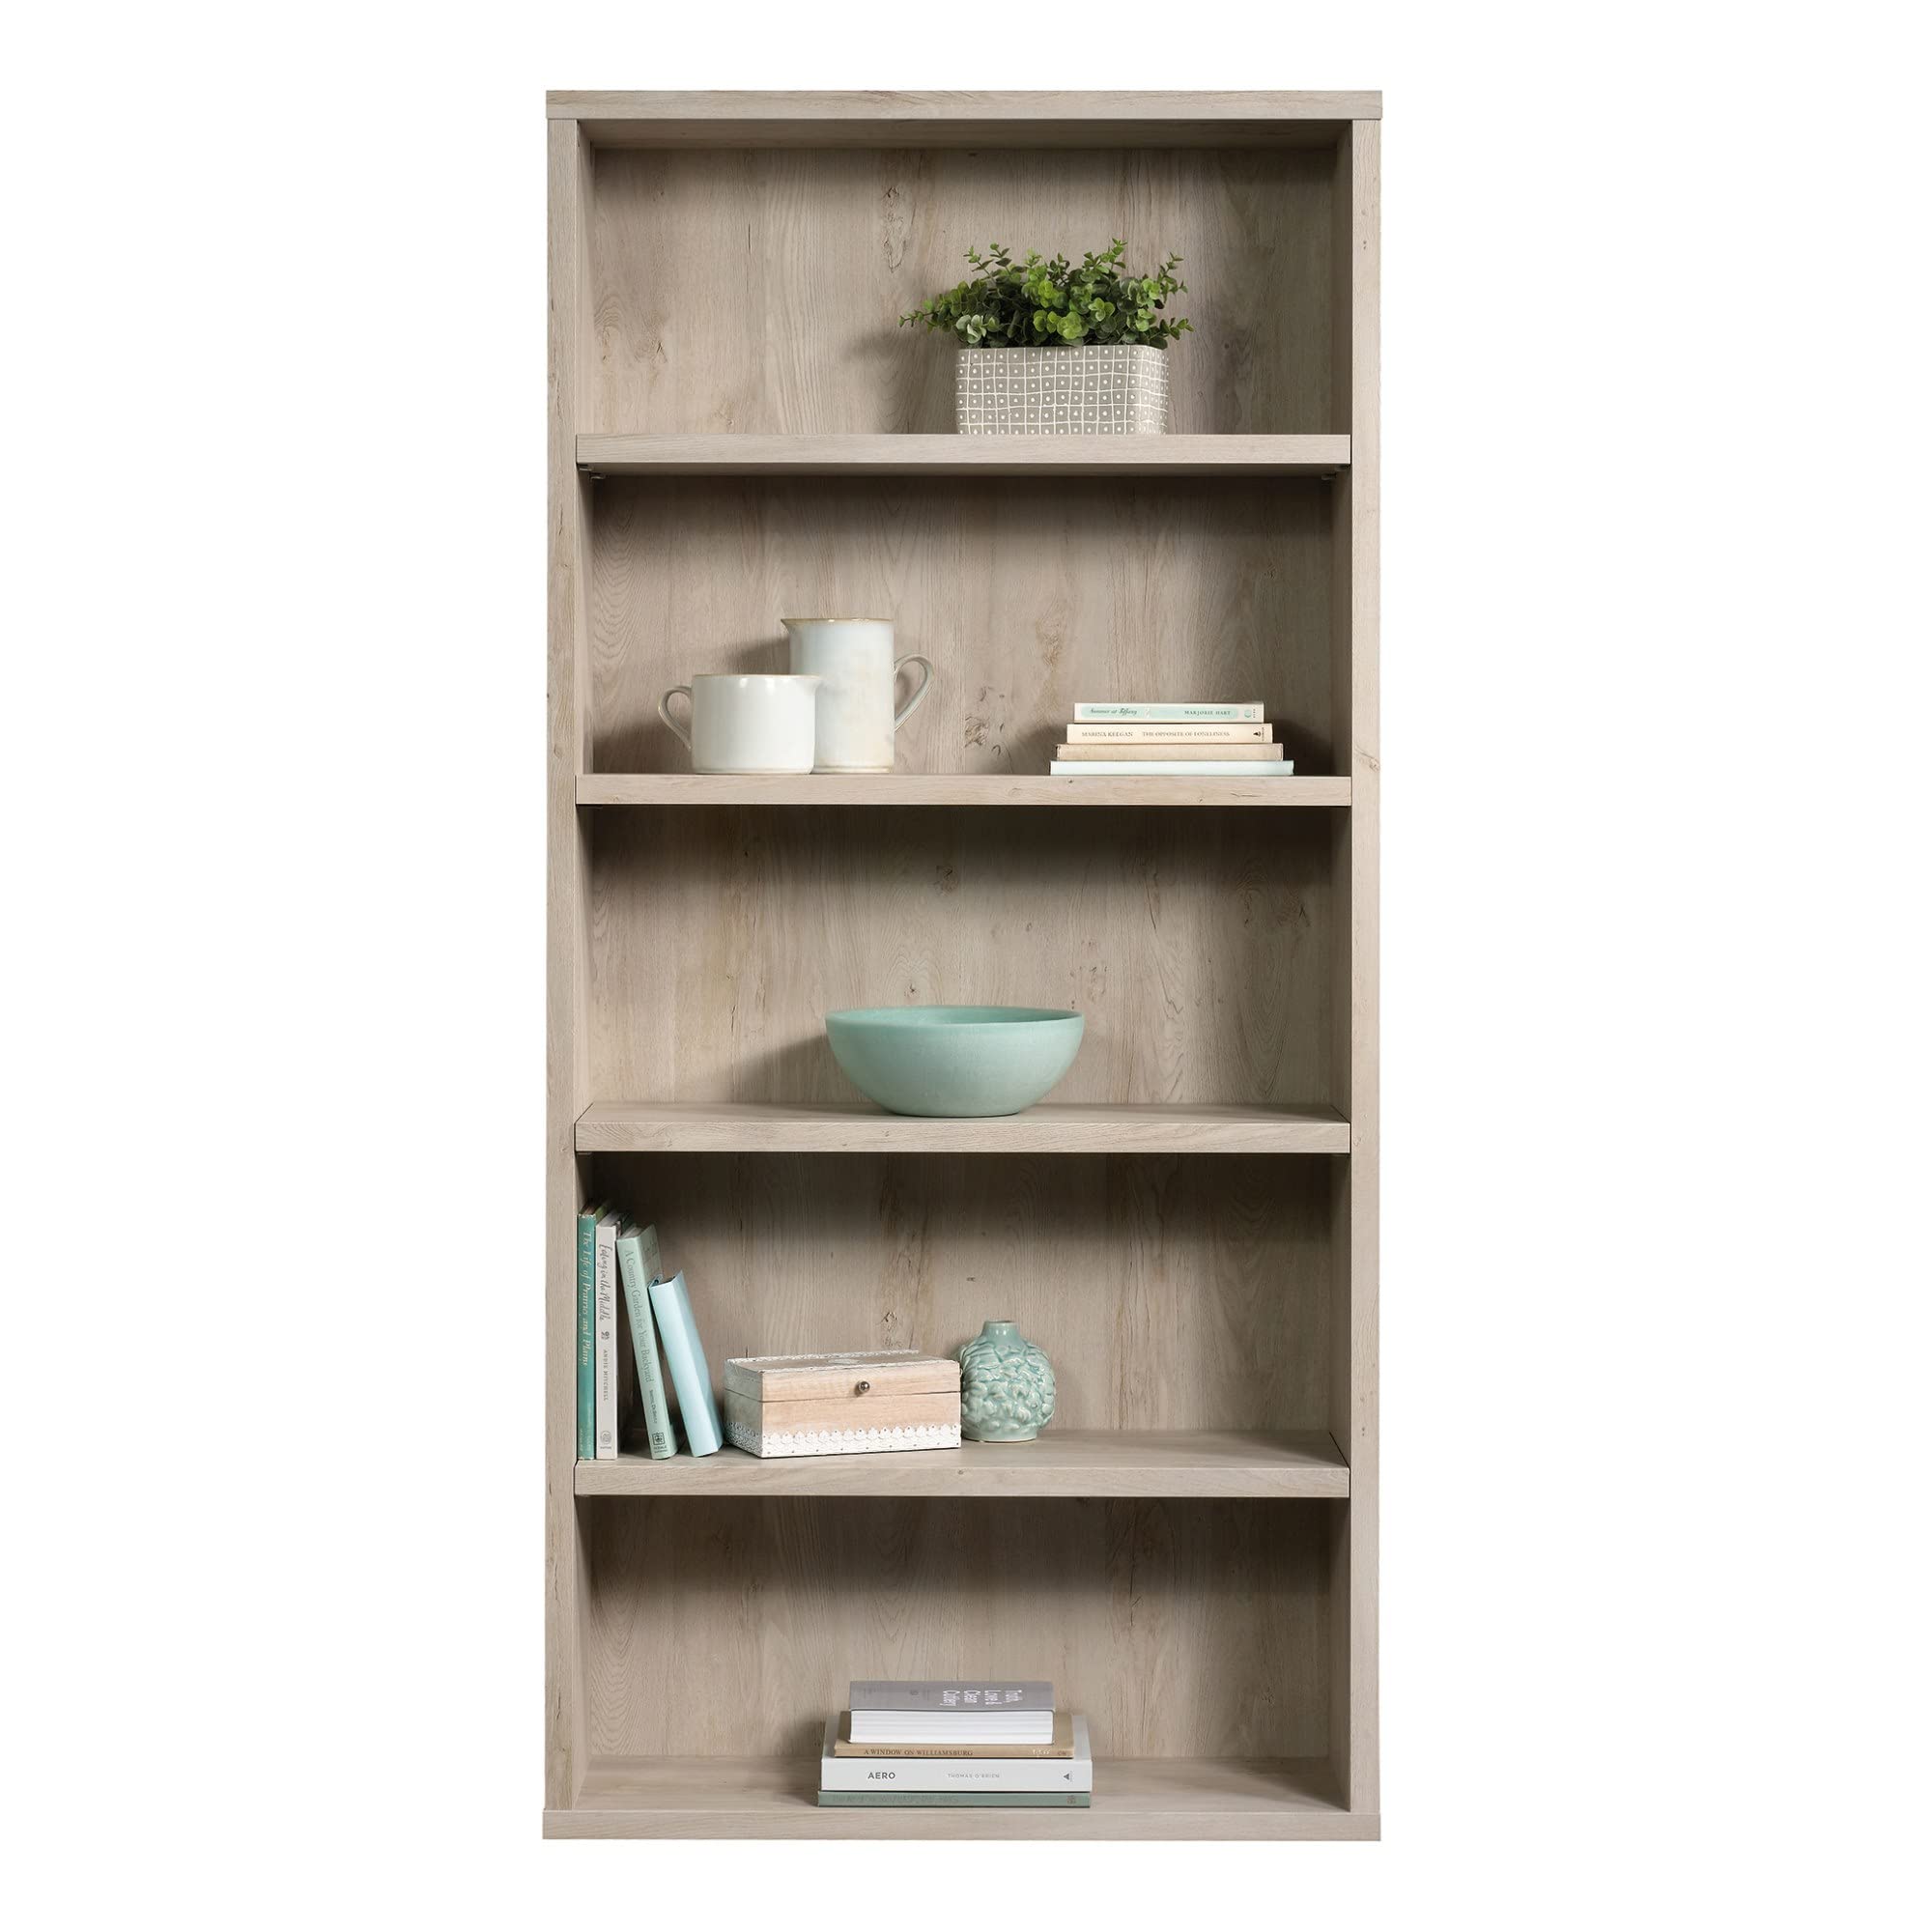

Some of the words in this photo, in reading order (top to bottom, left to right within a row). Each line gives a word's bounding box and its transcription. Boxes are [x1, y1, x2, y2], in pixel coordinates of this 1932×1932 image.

[582, 1232, 592, 1245] The
[581, 1250, 592, 1266] Life
[581, 1269, 591, 1280] of
[626, 1258, 637, 1289] Country
[631, 1290, 643, 1318] Garden
[582, 1318, 591, 1337] and
[635, 1318, 644, 1330] for
[638, 1329, 647, 1348] Your
[640, 1349, 654, 1382] Backyard
